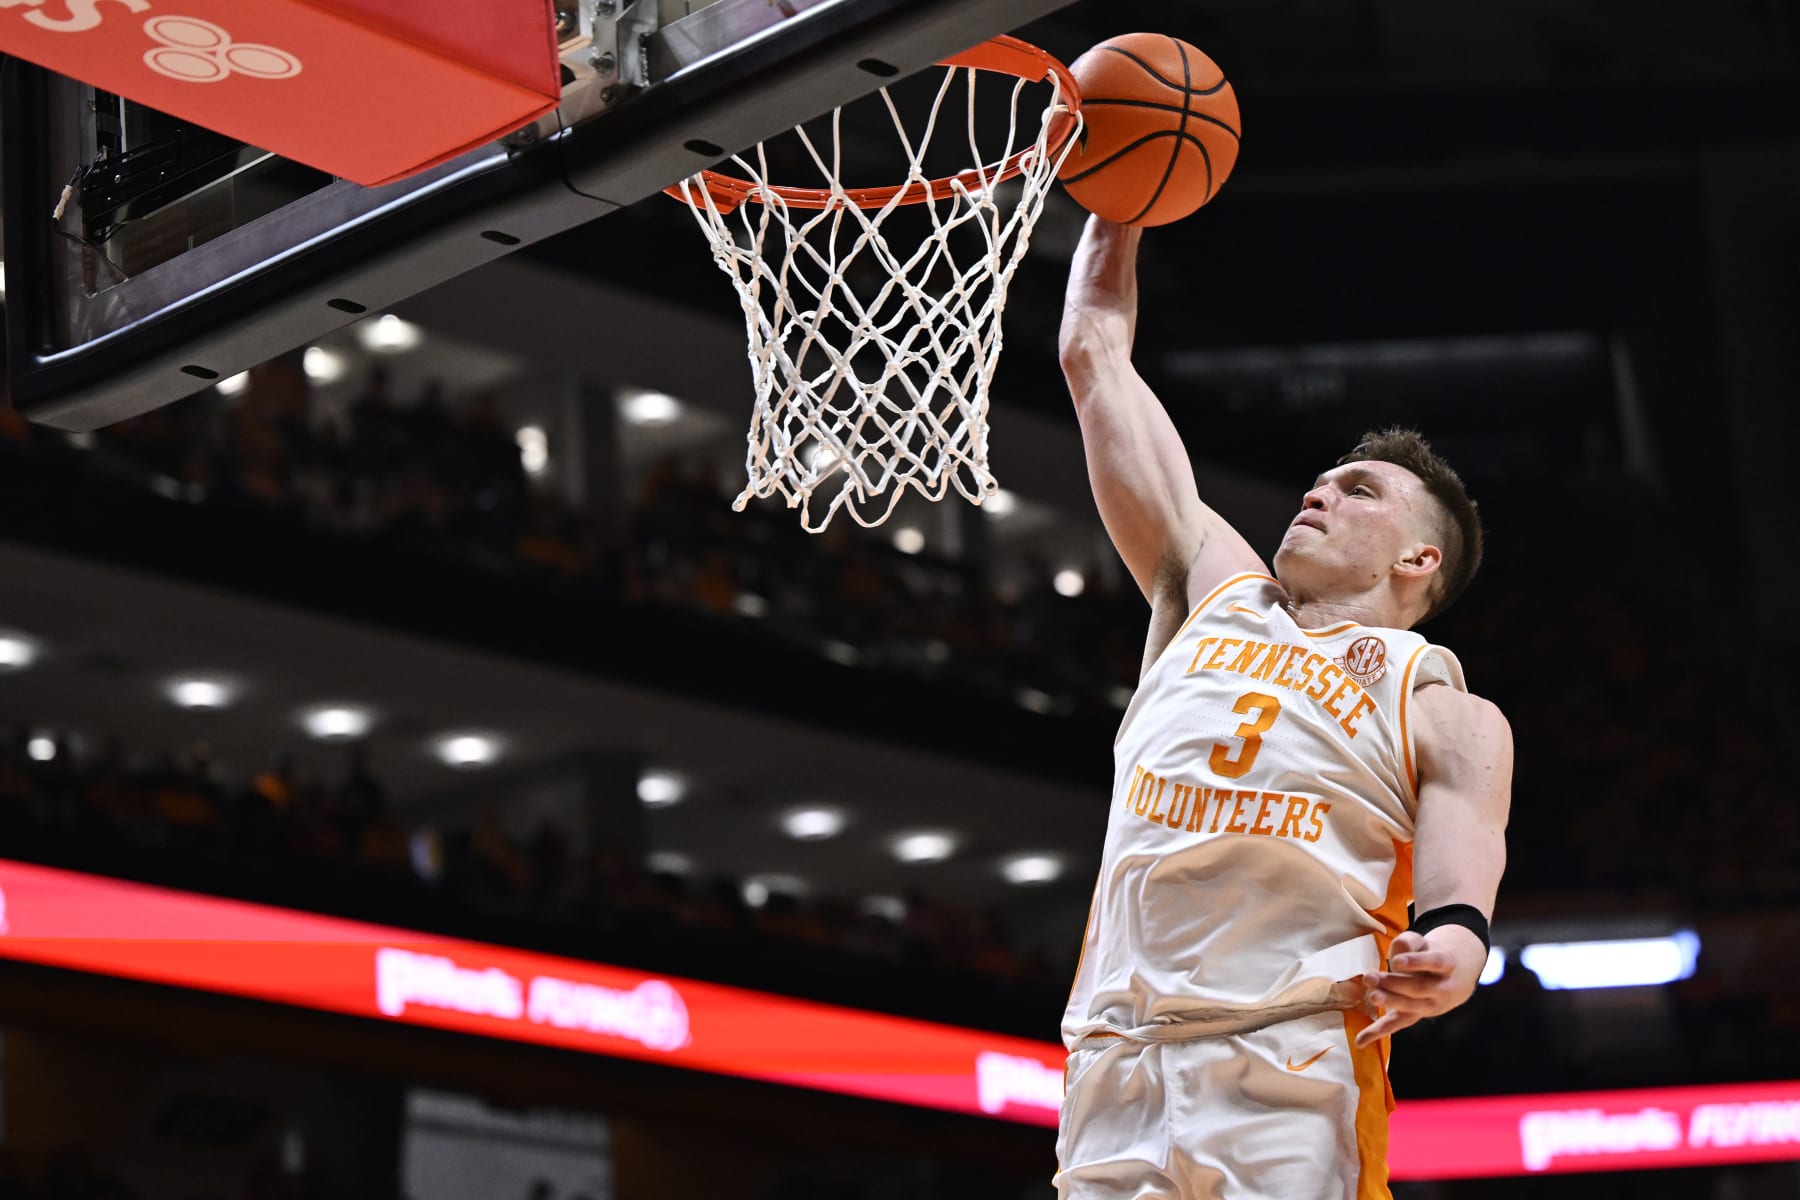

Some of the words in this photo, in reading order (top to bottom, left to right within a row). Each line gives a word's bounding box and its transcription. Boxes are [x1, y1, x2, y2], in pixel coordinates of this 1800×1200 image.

[1186, 637, 1377, 739] TENNESSEE
[1347, 638, 1385, 674] SEC
[1208, 691, 1282, 779] 3
[1125, 764, 1332, 842] VOLUNTEERS
